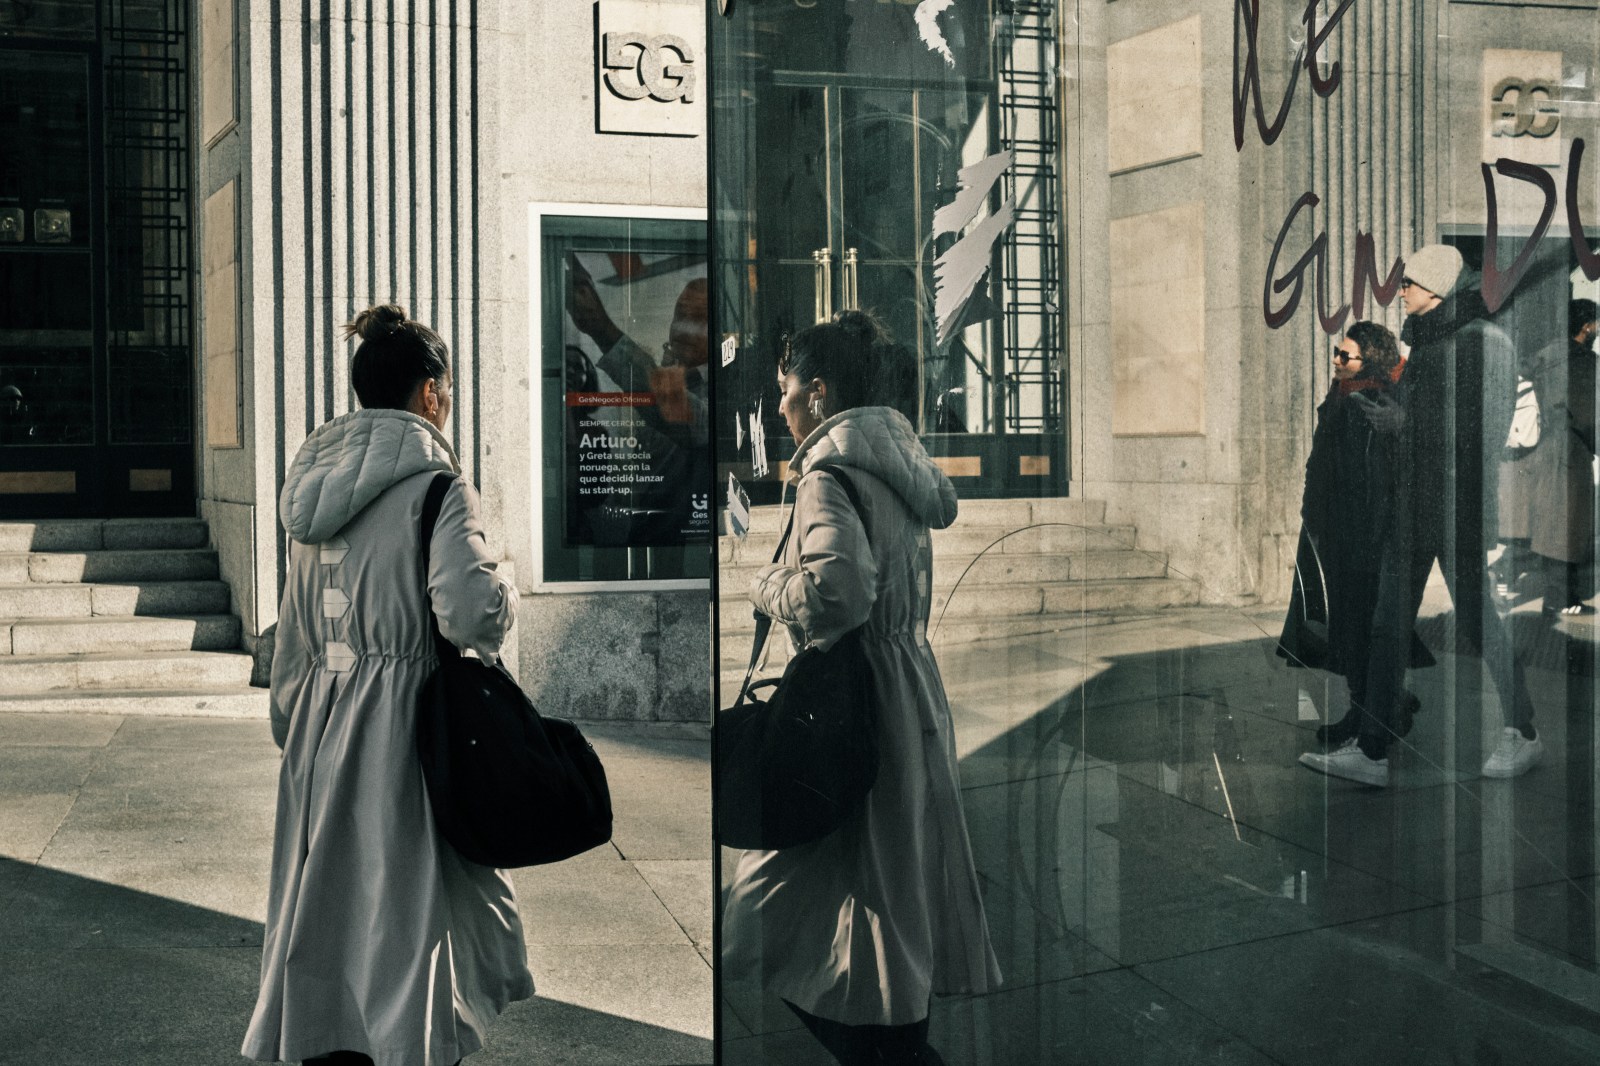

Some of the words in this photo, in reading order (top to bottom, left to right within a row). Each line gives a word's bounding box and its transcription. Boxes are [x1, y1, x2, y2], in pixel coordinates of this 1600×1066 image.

[578, 396, 621, 405] GesNegocio
[579, 433, 642, 450] Arturo,
[579, 453, 585, 462] y
[586, 451, 612, 460] Greta
[627, 451, 651, 460] socia
[580, 464, 621, 473] noruega,
[641, 462, 651, 471] la
[580, 475, 598, 484] que
[600, 474, 634, 483] decidió
[635, 474, 665, 482] lanzar
[580, 487, 591, 495] su
[592, 486, 633, 496] start-up.
[692, 511, 708, 519] Ges
